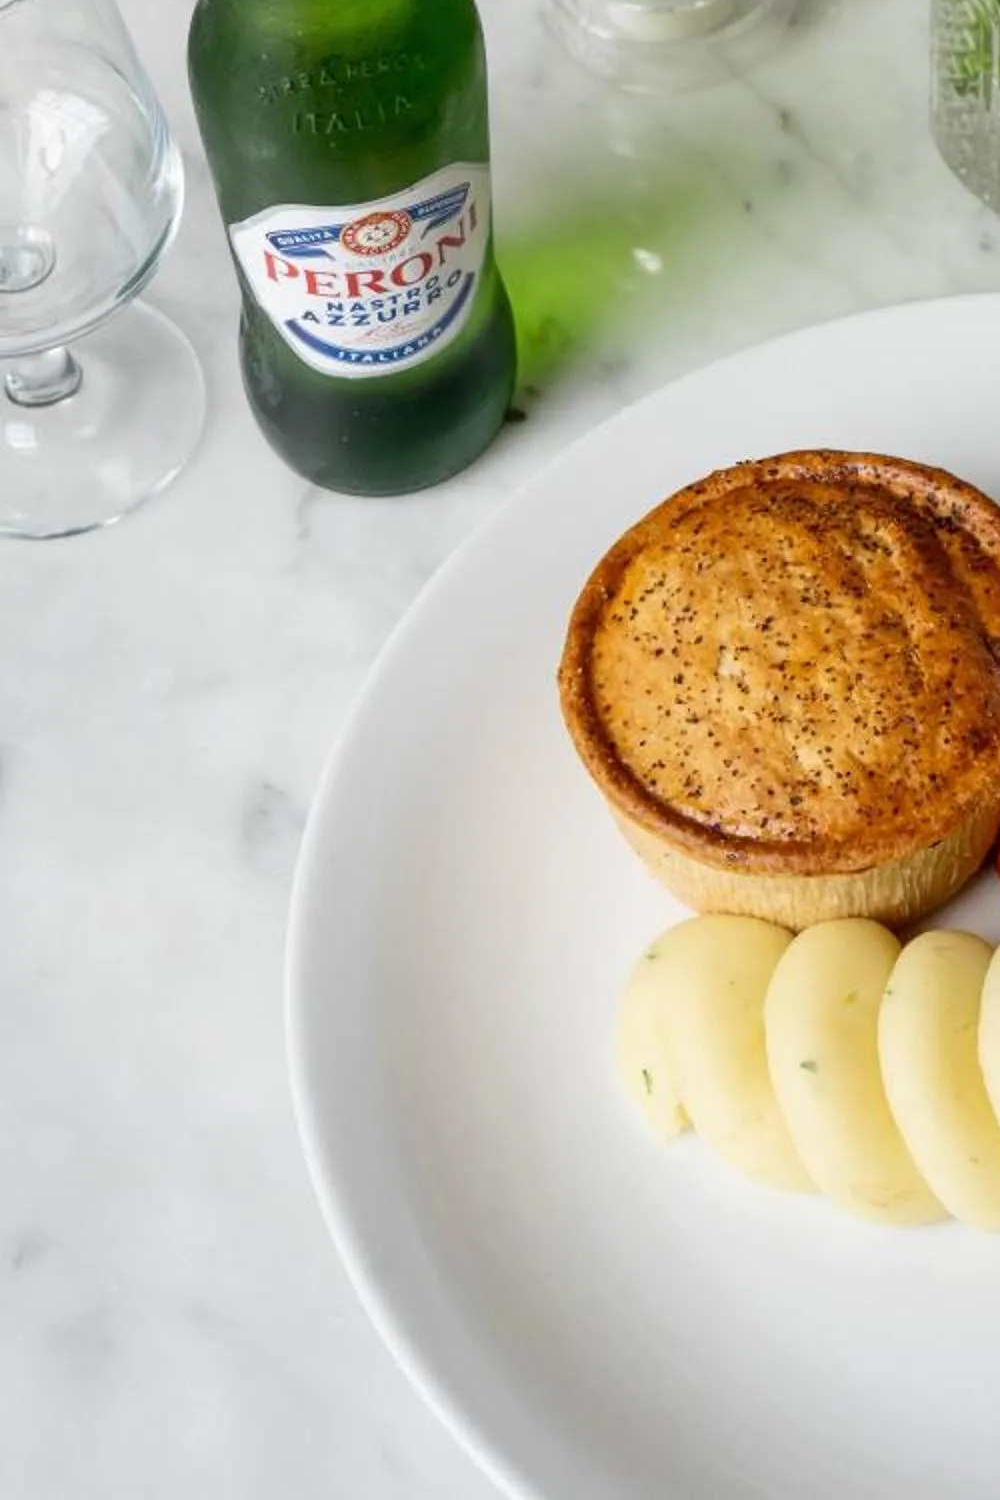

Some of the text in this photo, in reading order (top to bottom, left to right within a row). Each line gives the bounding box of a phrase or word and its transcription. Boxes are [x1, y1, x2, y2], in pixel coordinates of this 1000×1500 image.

[292, 95, 413, 135] ITALIA
[264, 202, 478, 298] PERONI
[303, 269, 461, 326] AZZURRO
[327, 275, 440, 312] NASTRO
